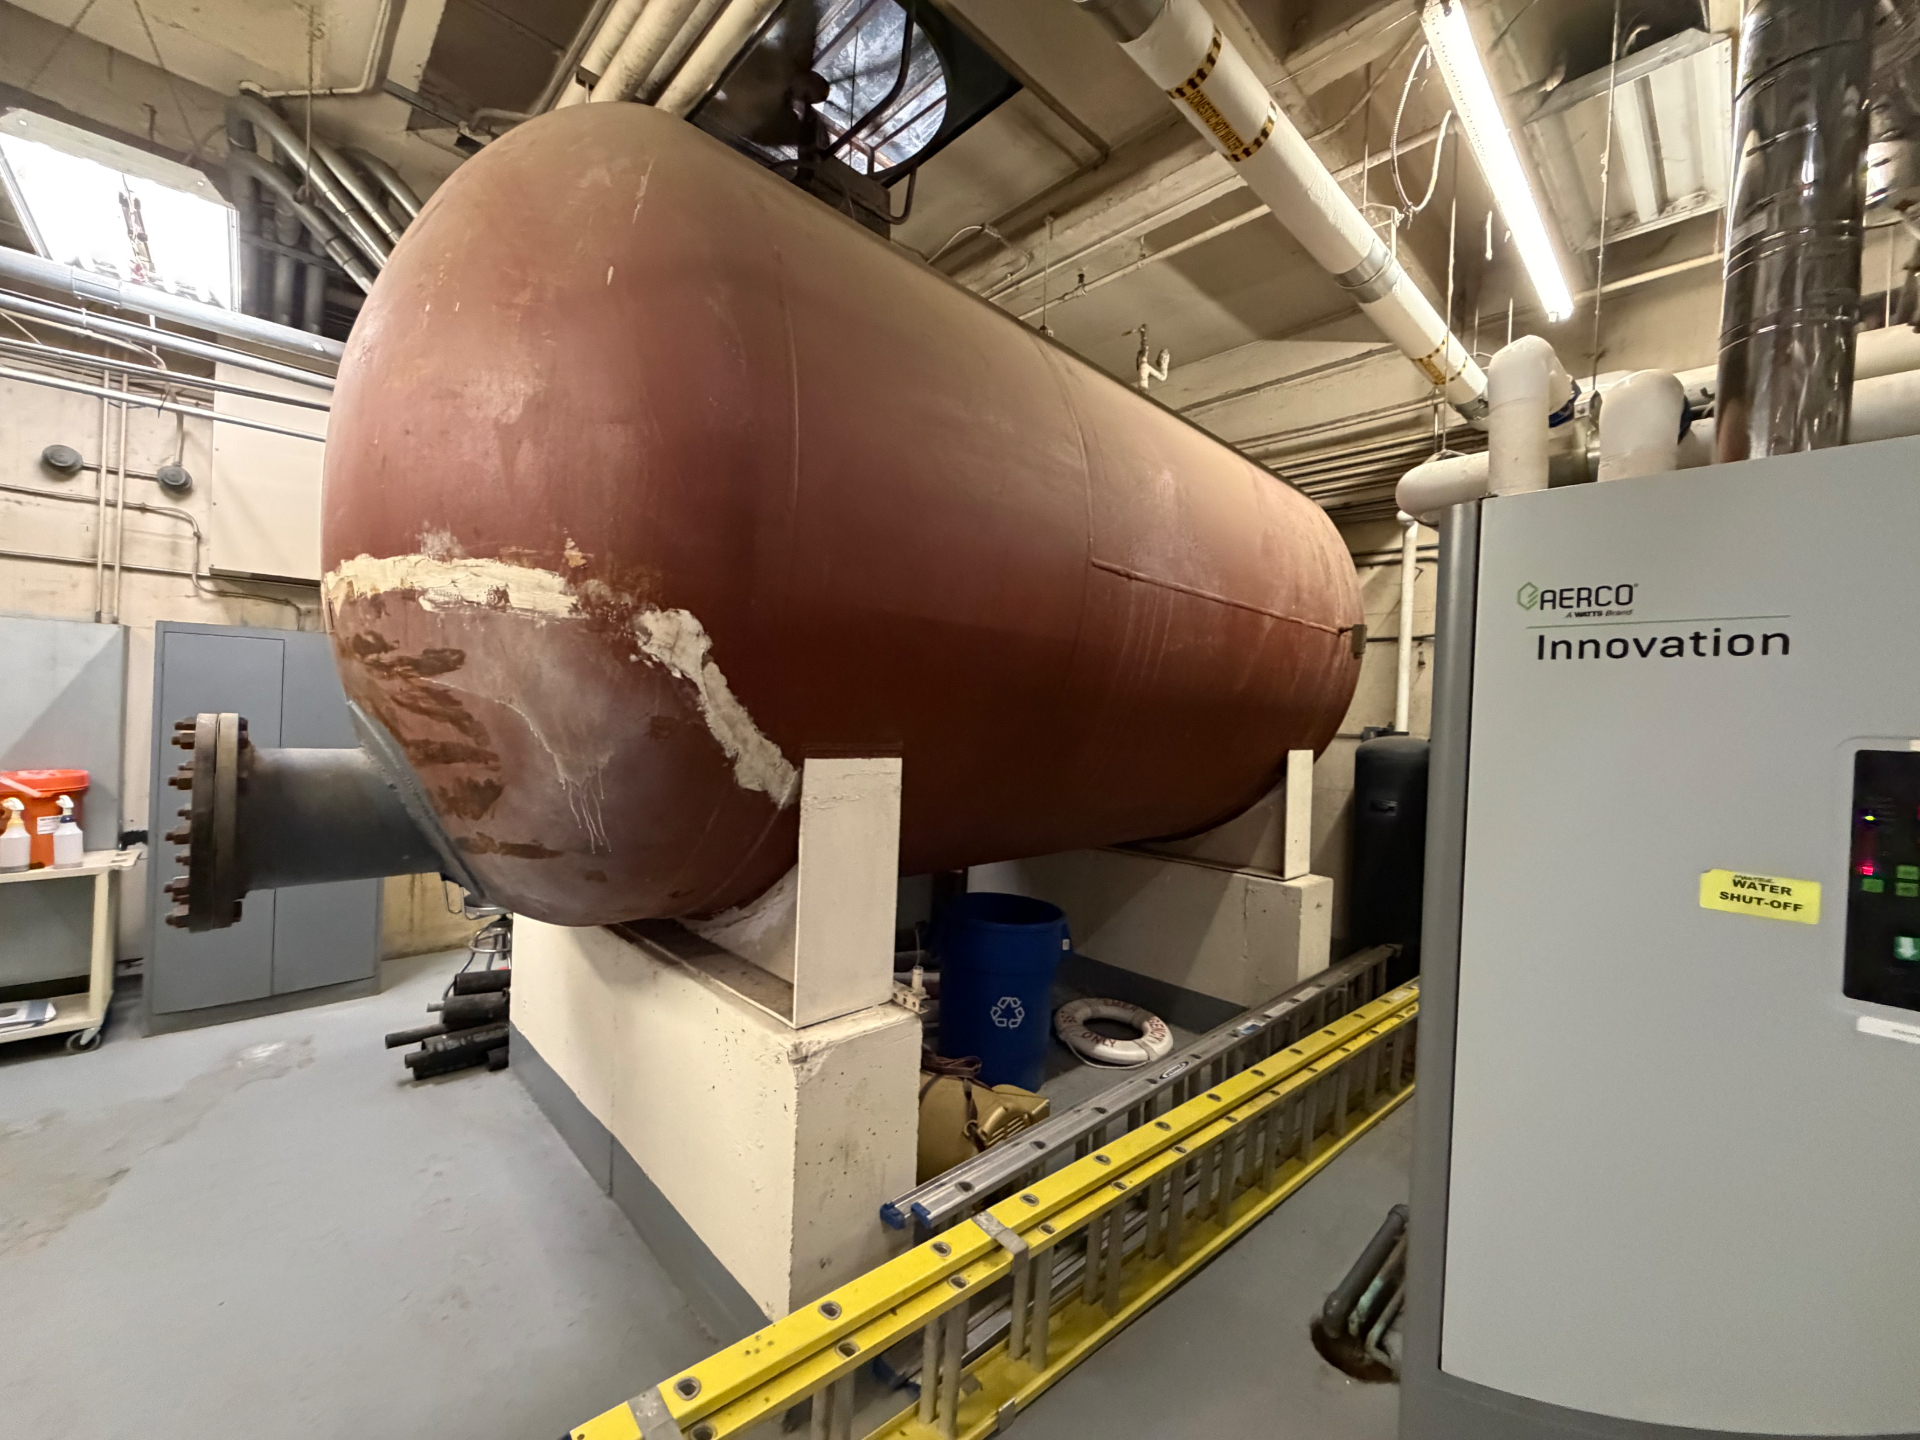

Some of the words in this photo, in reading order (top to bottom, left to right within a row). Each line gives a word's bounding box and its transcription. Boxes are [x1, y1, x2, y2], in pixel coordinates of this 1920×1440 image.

[1185, 89, 1220, 126] DOMESTIC
[1209, 117, 1230, 136] HOT
[1219, 129, 1244, 152] WATER
[1540, 584, 1634, 610] AERCO
[1537, 628, 1791, 660] Innovation
[1732, 879, 1792, 896] WATER
[1719, 891, 1804, 912] SHUT-OFF
[1081, 1031, 1116, 1048] ONLY
